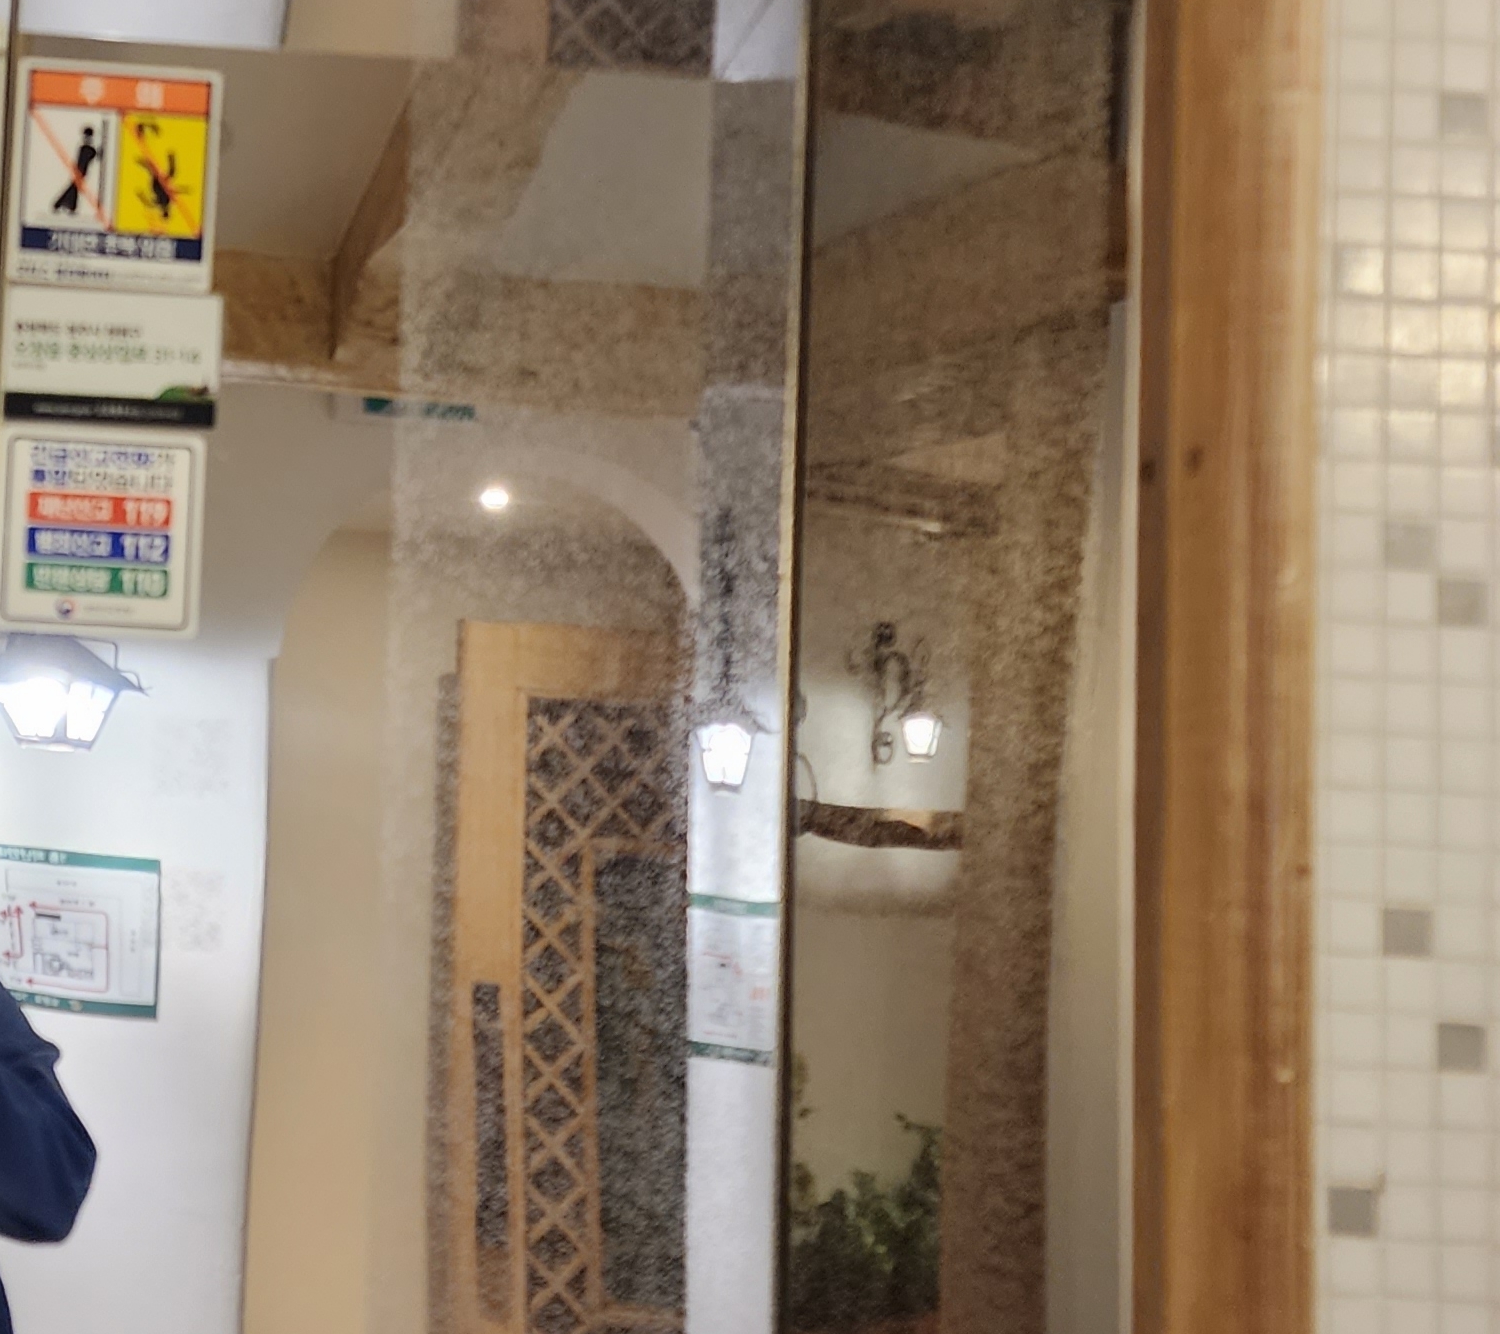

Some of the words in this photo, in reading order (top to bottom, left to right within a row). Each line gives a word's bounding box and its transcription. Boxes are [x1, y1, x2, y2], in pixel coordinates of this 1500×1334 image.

[122, 499, 168, 527] 119
[120, 533, 168, 563] 112
[119, 569, 167, 598] 110
